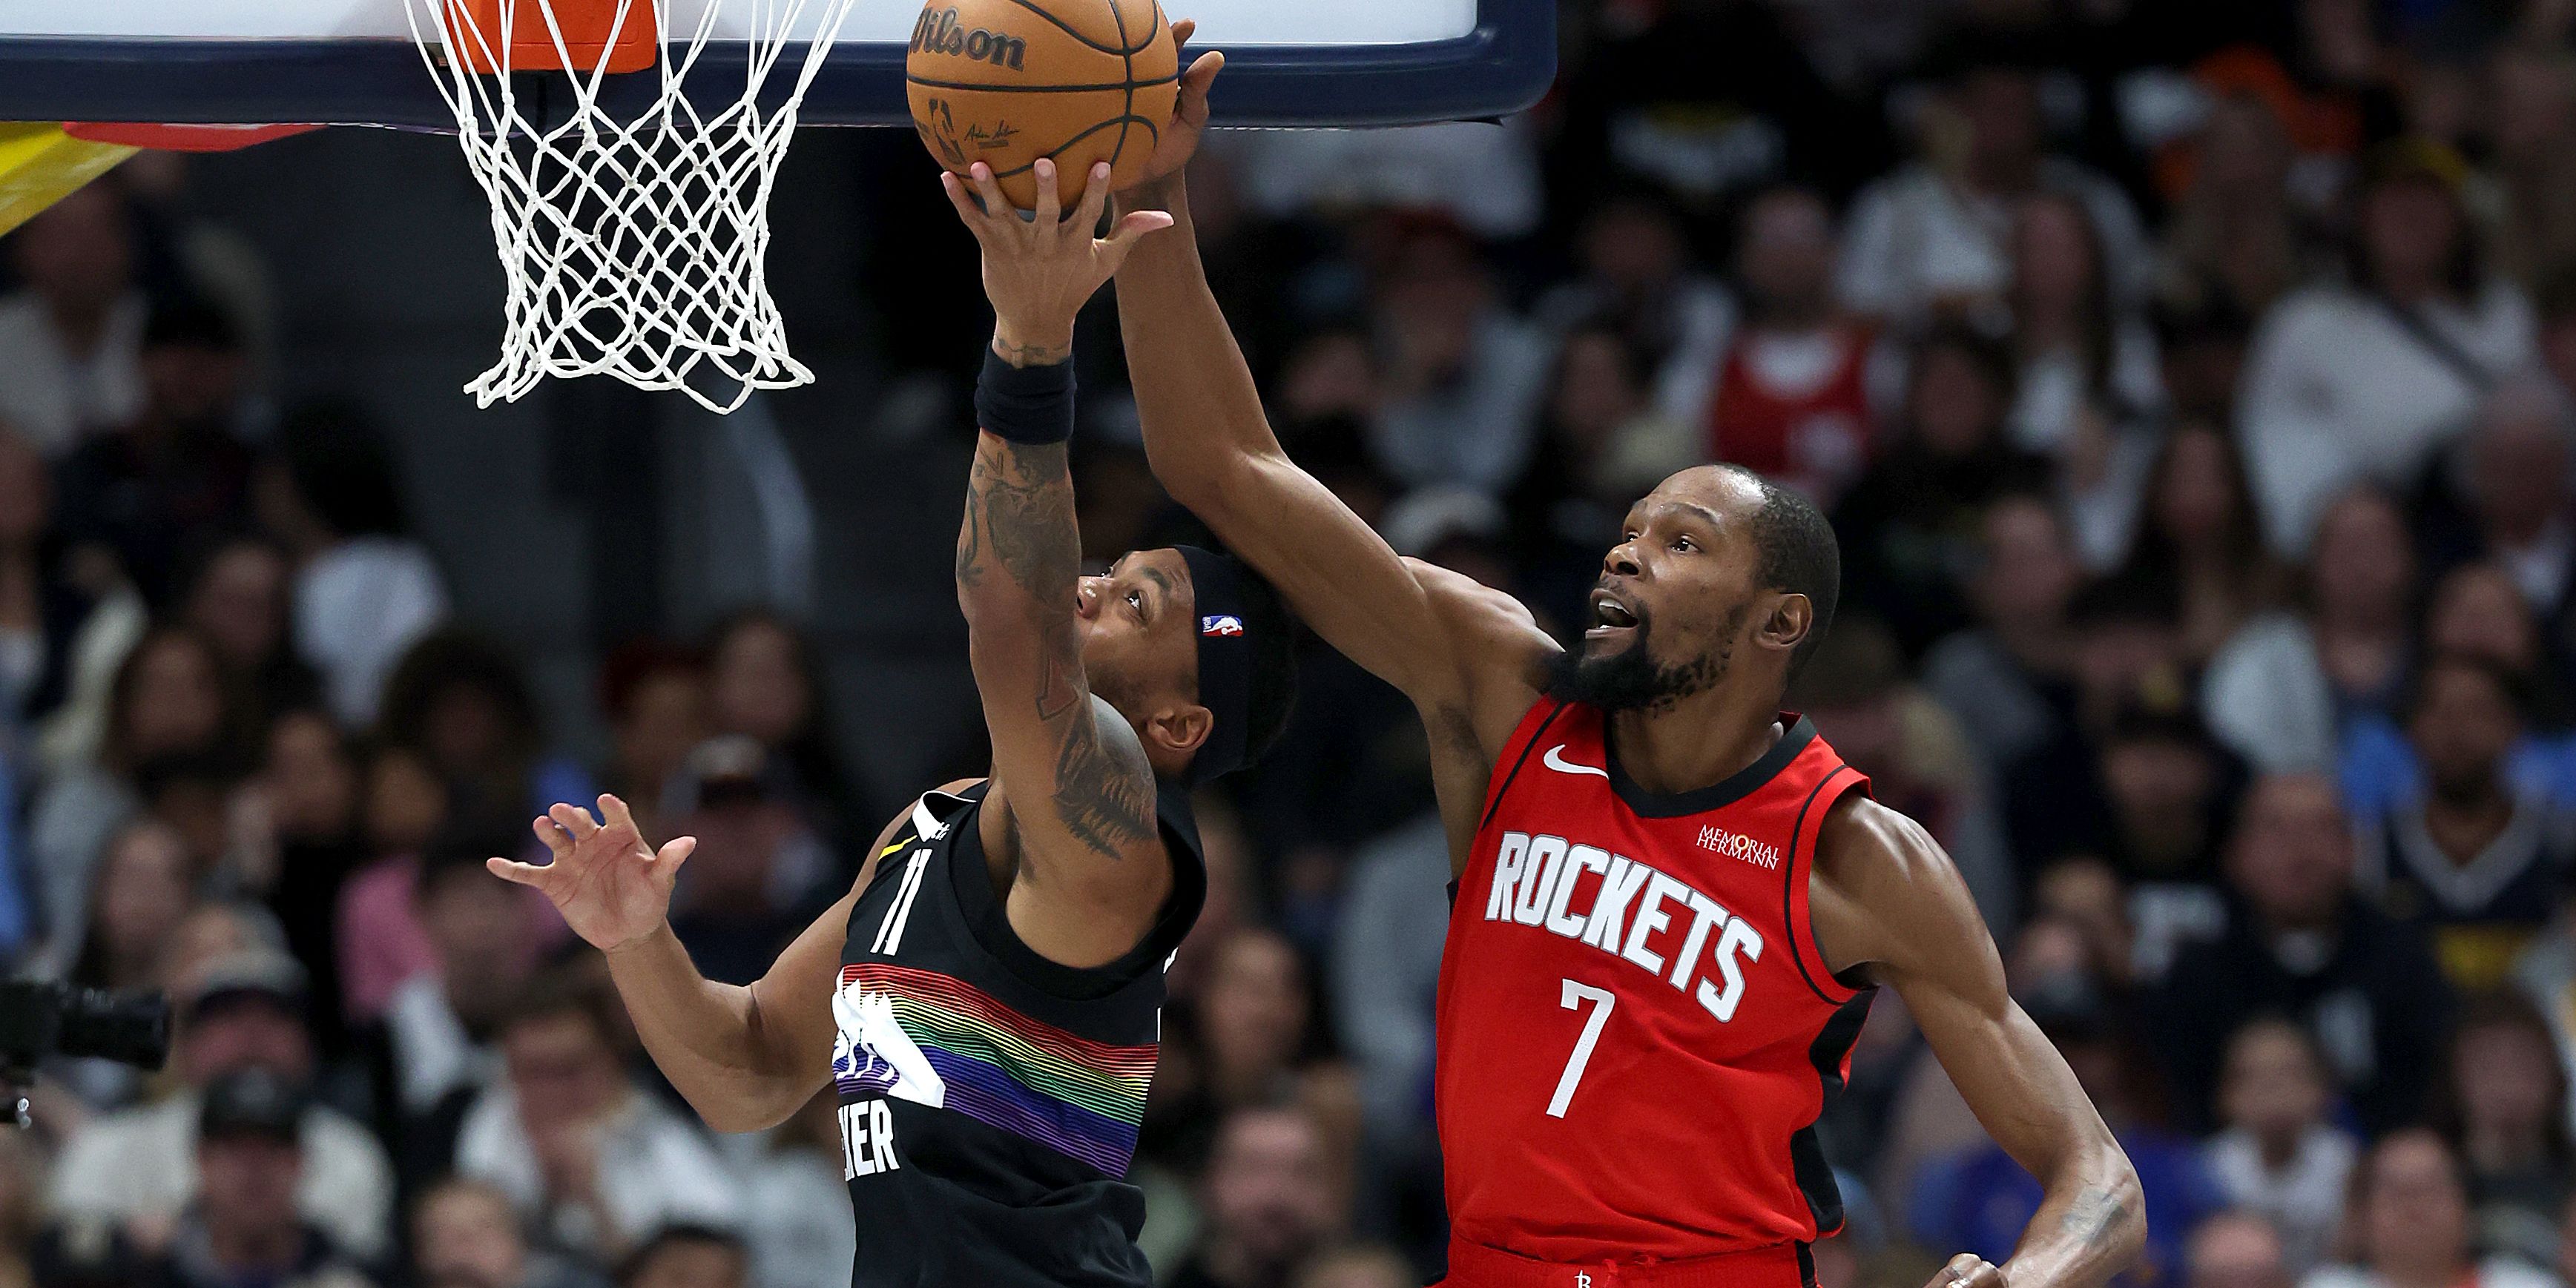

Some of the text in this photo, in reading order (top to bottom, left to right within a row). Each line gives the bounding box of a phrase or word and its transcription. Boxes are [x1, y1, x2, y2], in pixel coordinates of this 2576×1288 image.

[1696, 833, 1779, 871] HERMANN
[1699, 824, 1779, 860] MEMORIAL
[870, 848, 933, 956] 11
[1484, 831, 1764, 1023] ROCKETS
[1546, 978, 1615, 1118] 7
